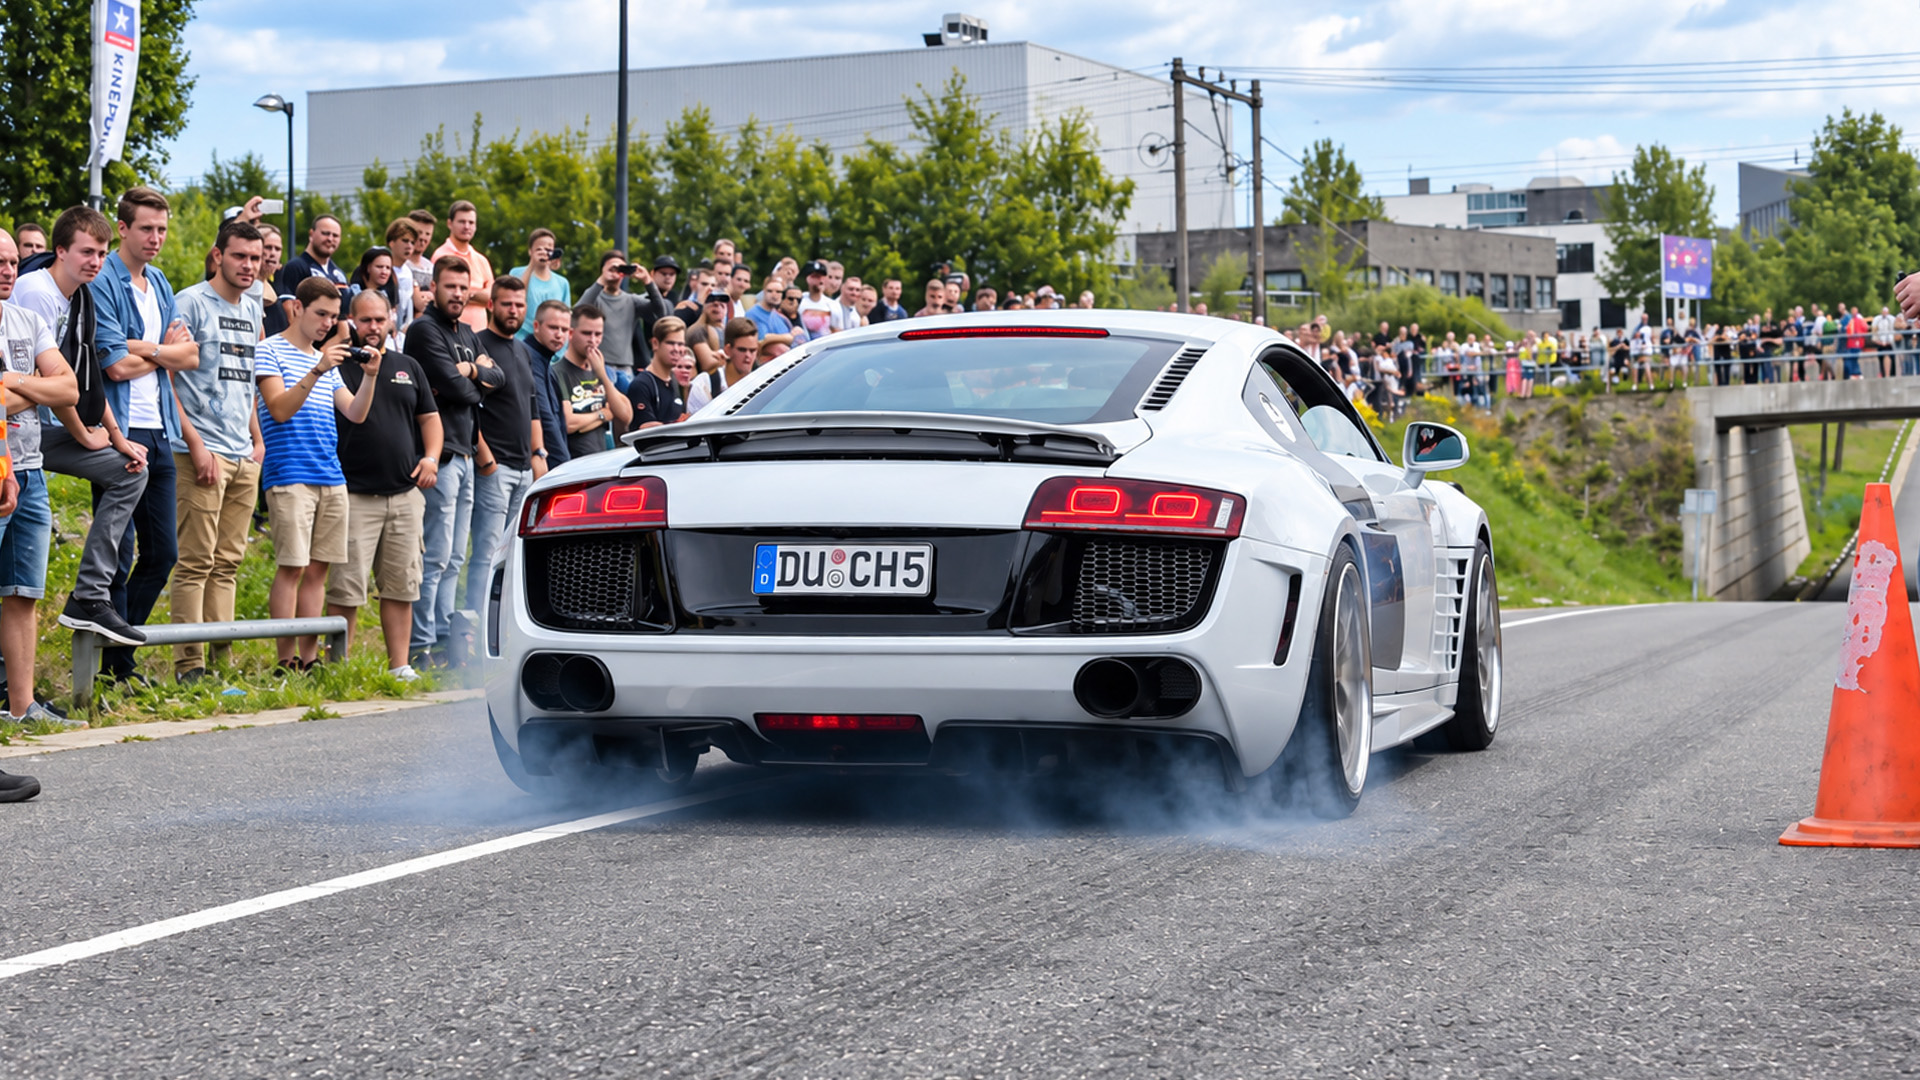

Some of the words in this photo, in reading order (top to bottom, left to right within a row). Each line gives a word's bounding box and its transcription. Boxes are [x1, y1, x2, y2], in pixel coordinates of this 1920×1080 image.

[760, 573, 769, 585] D
[776, 551, 826, 587] DU
[849, 551, 925, 588] CH5
